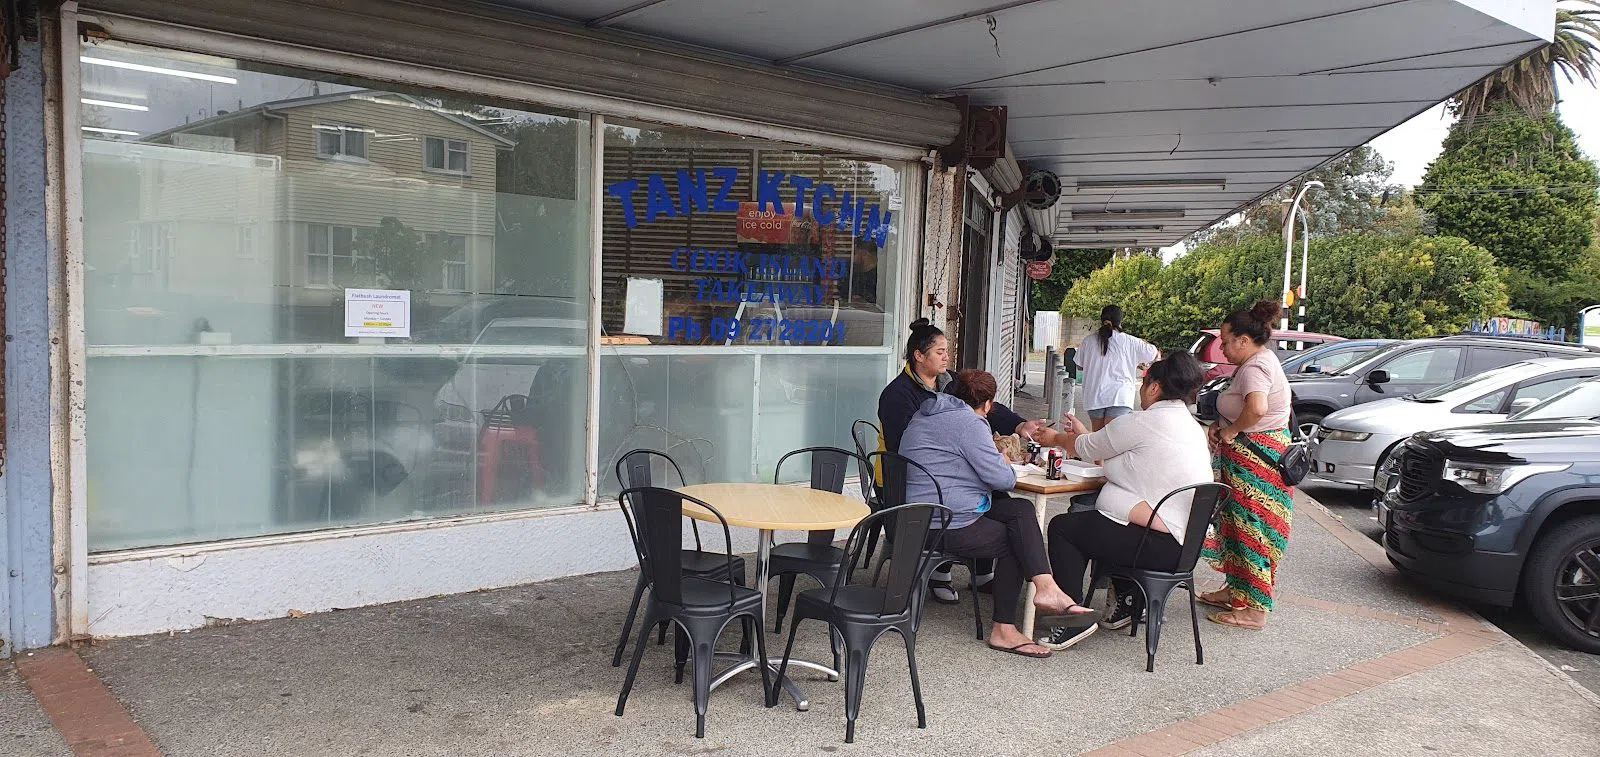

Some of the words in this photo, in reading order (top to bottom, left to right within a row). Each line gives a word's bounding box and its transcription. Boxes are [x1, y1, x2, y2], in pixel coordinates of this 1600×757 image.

[608, 167, 740, 230] TANZ
[759, 170, 892, 249] KTCHN
[748, 210, 776, 219] enjoy
[742, 220, 757, 230] ice
[760, 220, 782, 230] cold
[671, 248, 749, 275] COOK
[760, 254, 848, 280] ISLAND
[694, 278, 828, 305] TAKEAWAY
[668, 316, 700, 341] Ph
[711, 317, 741, 341] 09
